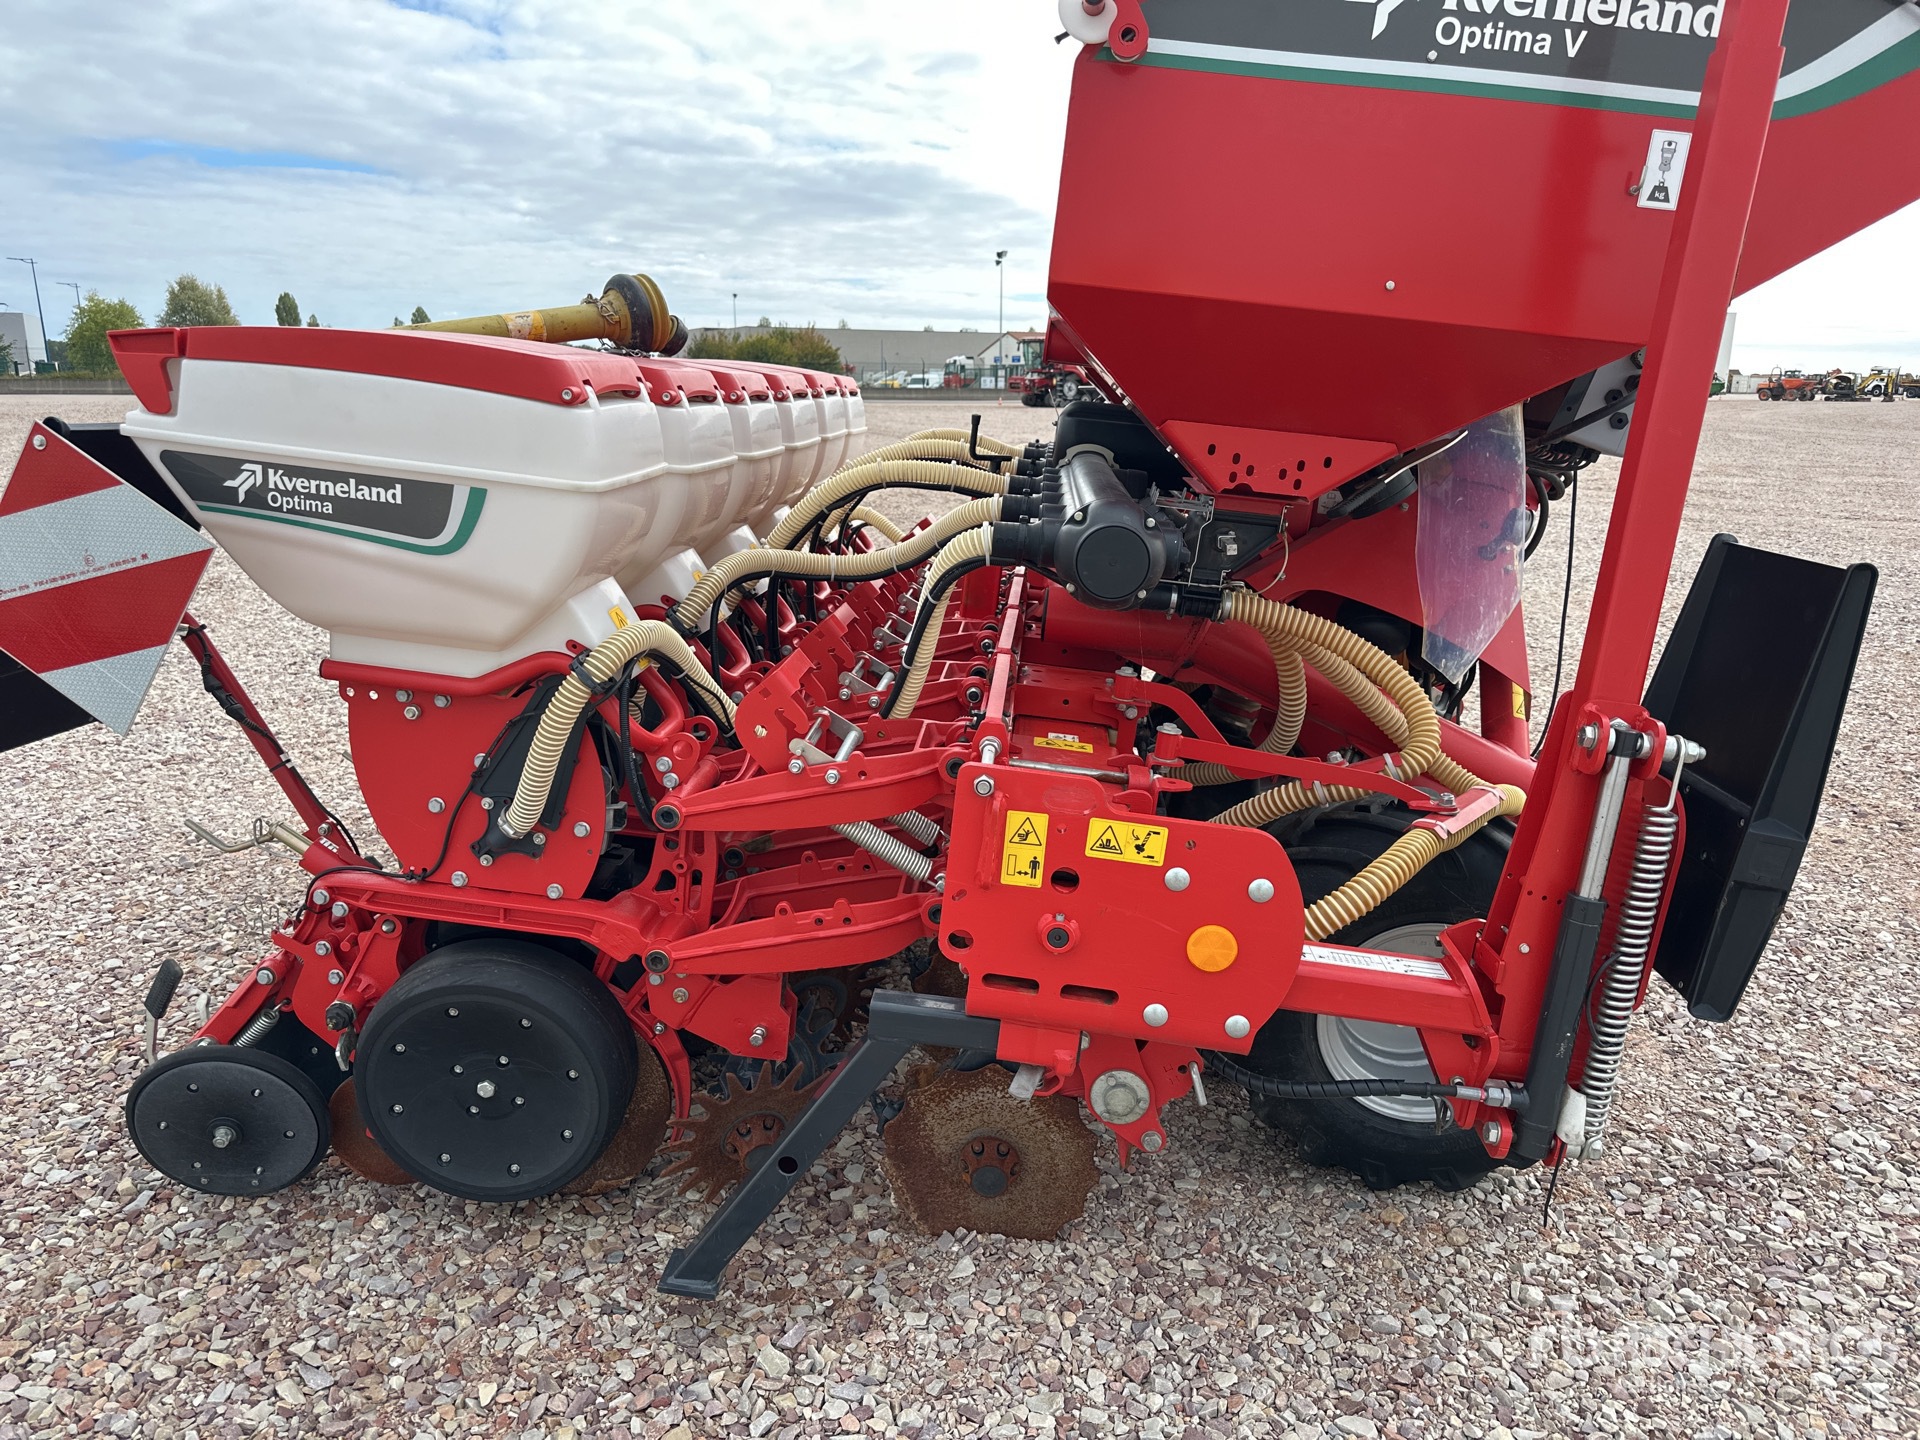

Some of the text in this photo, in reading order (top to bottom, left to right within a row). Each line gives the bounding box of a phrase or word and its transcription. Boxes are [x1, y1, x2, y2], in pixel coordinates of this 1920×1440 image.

[1435, 16, 1588, 58] Optima V
[1442, 0, 1726, 38] erneland
[1654, 190, 1666, 200] kg
[267, 468, 403, 505] Kverneland
[267, 491, 333, 514] Optima
